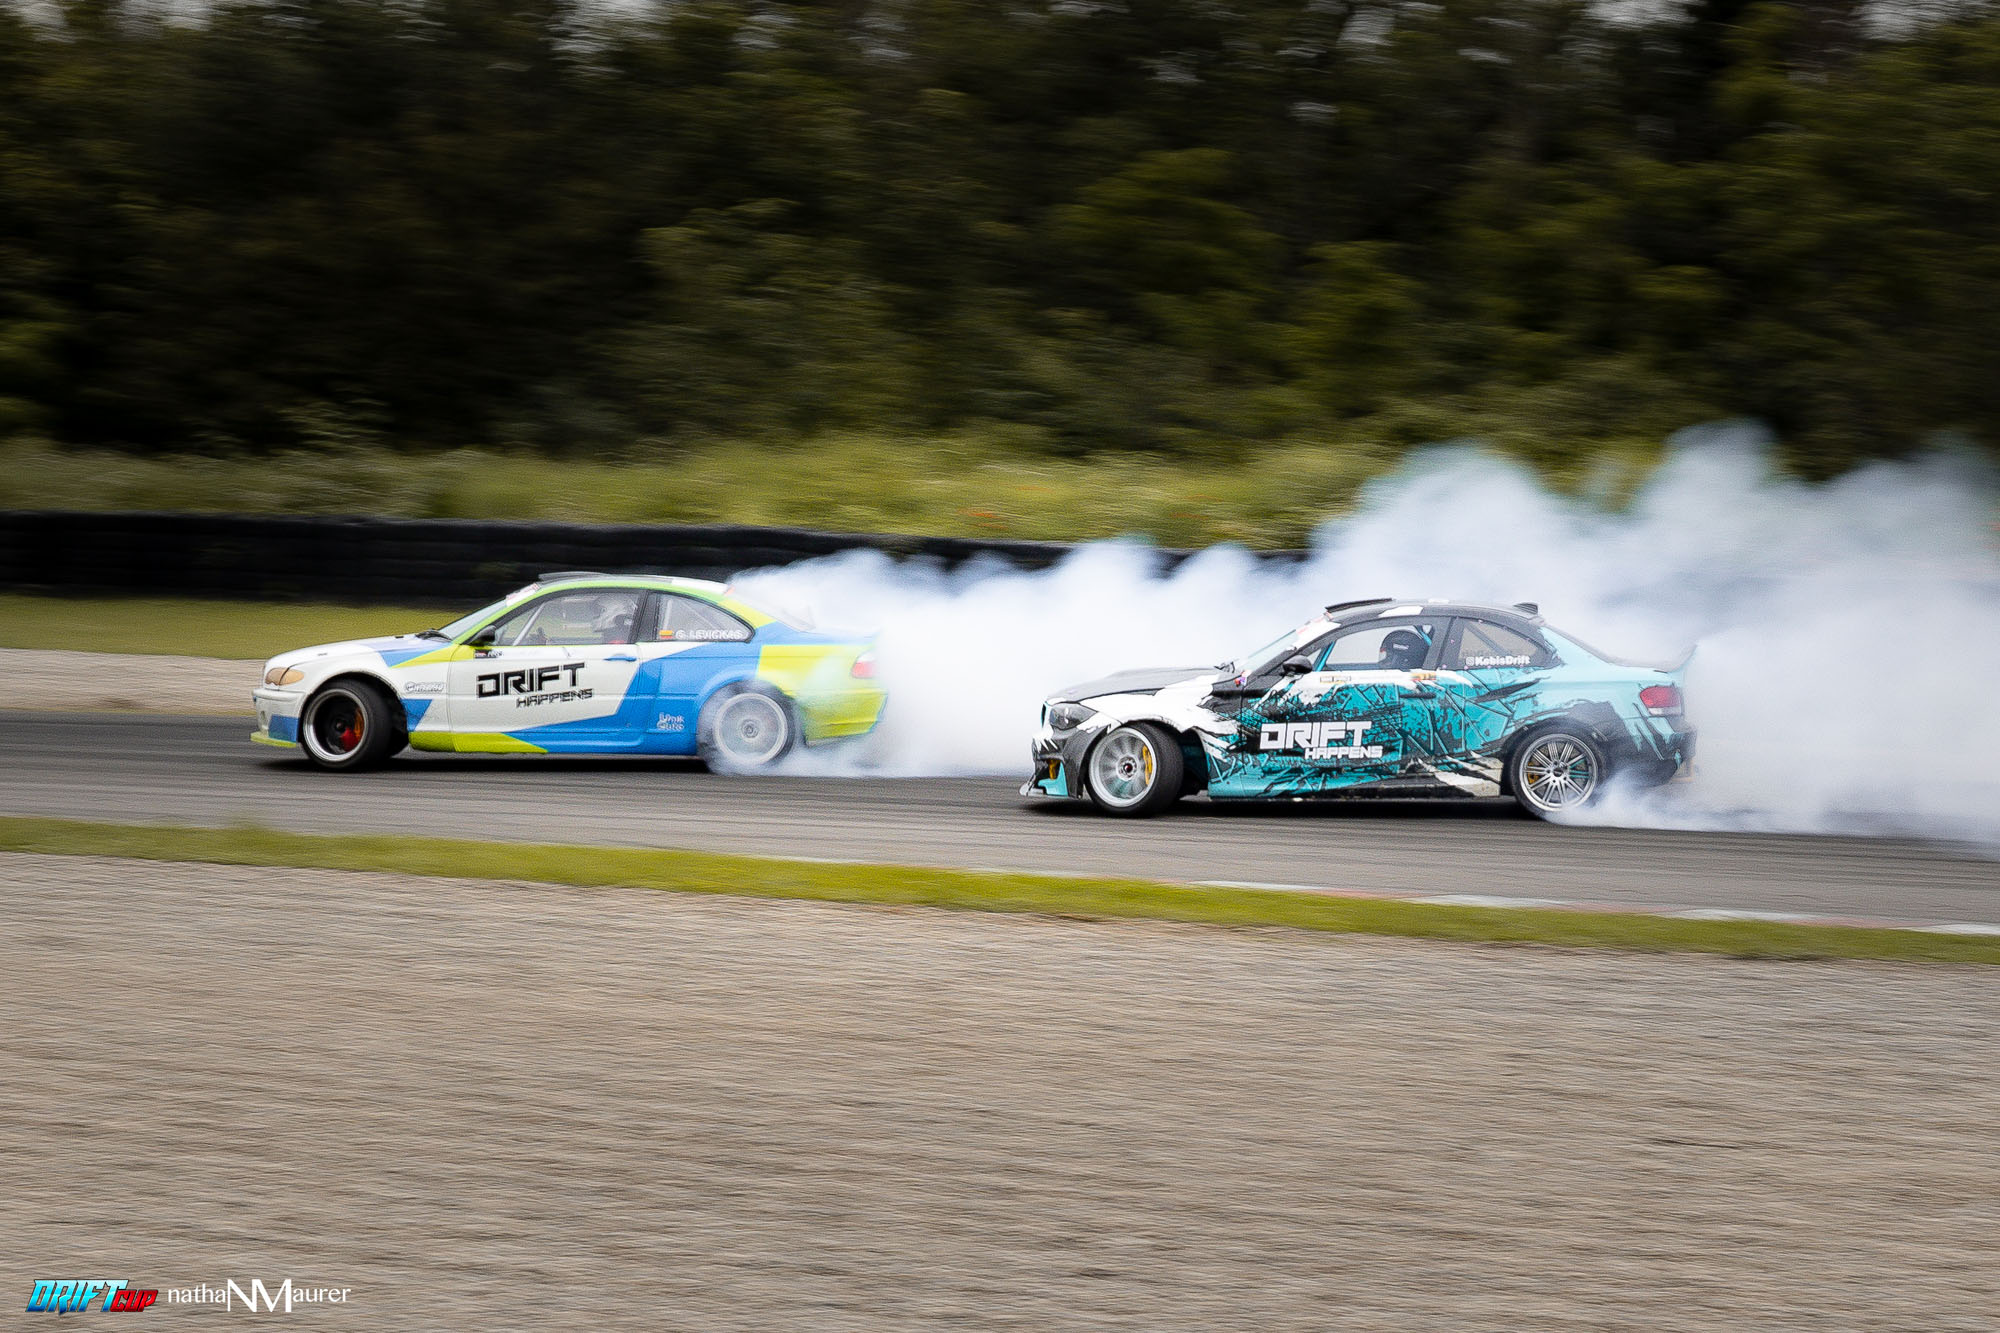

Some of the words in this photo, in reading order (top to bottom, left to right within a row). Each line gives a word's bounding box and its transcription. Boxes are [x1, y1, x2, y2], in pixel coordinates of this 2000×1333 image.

[477, 662, 585, 698] DRIFT
[516, 688, 594, 708] HAPPENS
[1259, 721, 1372, 749] DRIFT
[1304, 745, 1384, 760] HAPPENS
